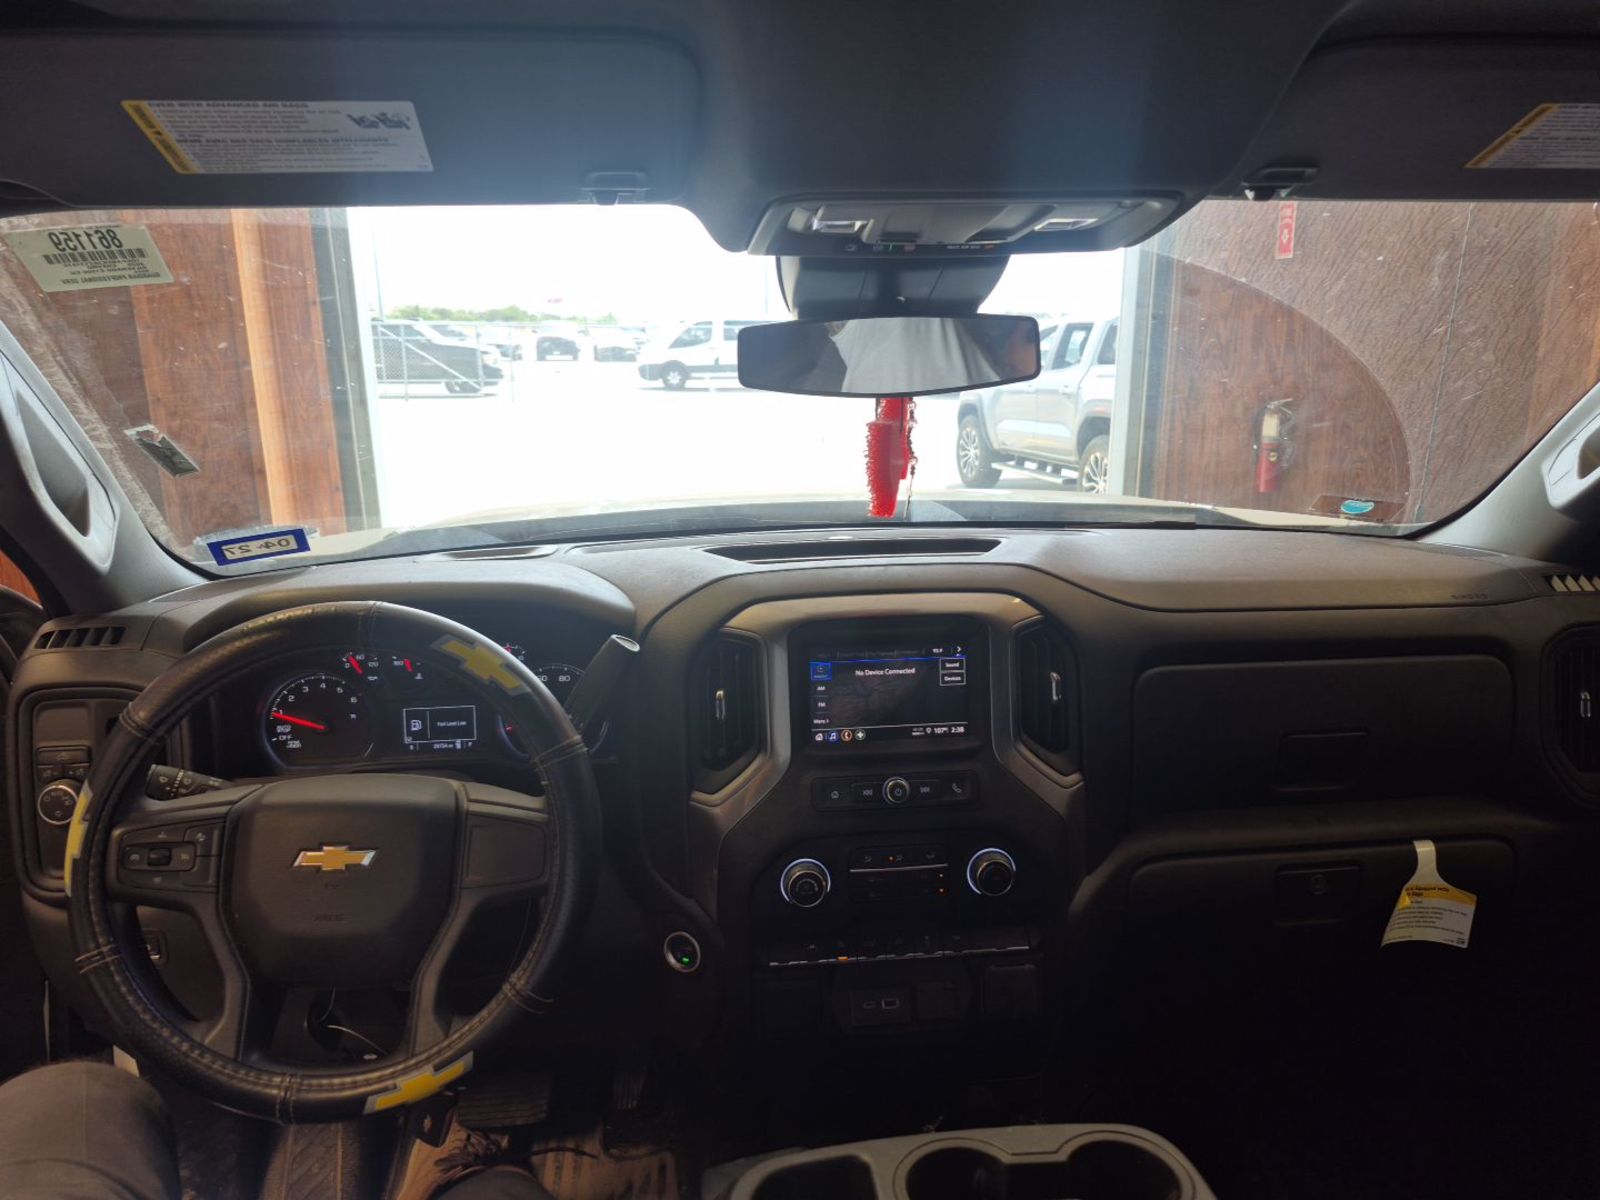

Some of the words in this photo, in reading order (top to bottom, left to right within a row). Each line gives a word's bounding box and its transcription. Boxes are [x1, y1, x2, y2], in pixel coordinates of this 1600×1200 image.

[855, 668, 864, 676] No
[865, 668, 884, 676] Device
[884, 667, 916, 676] Connected
[288, 694, 296, 702] 2
